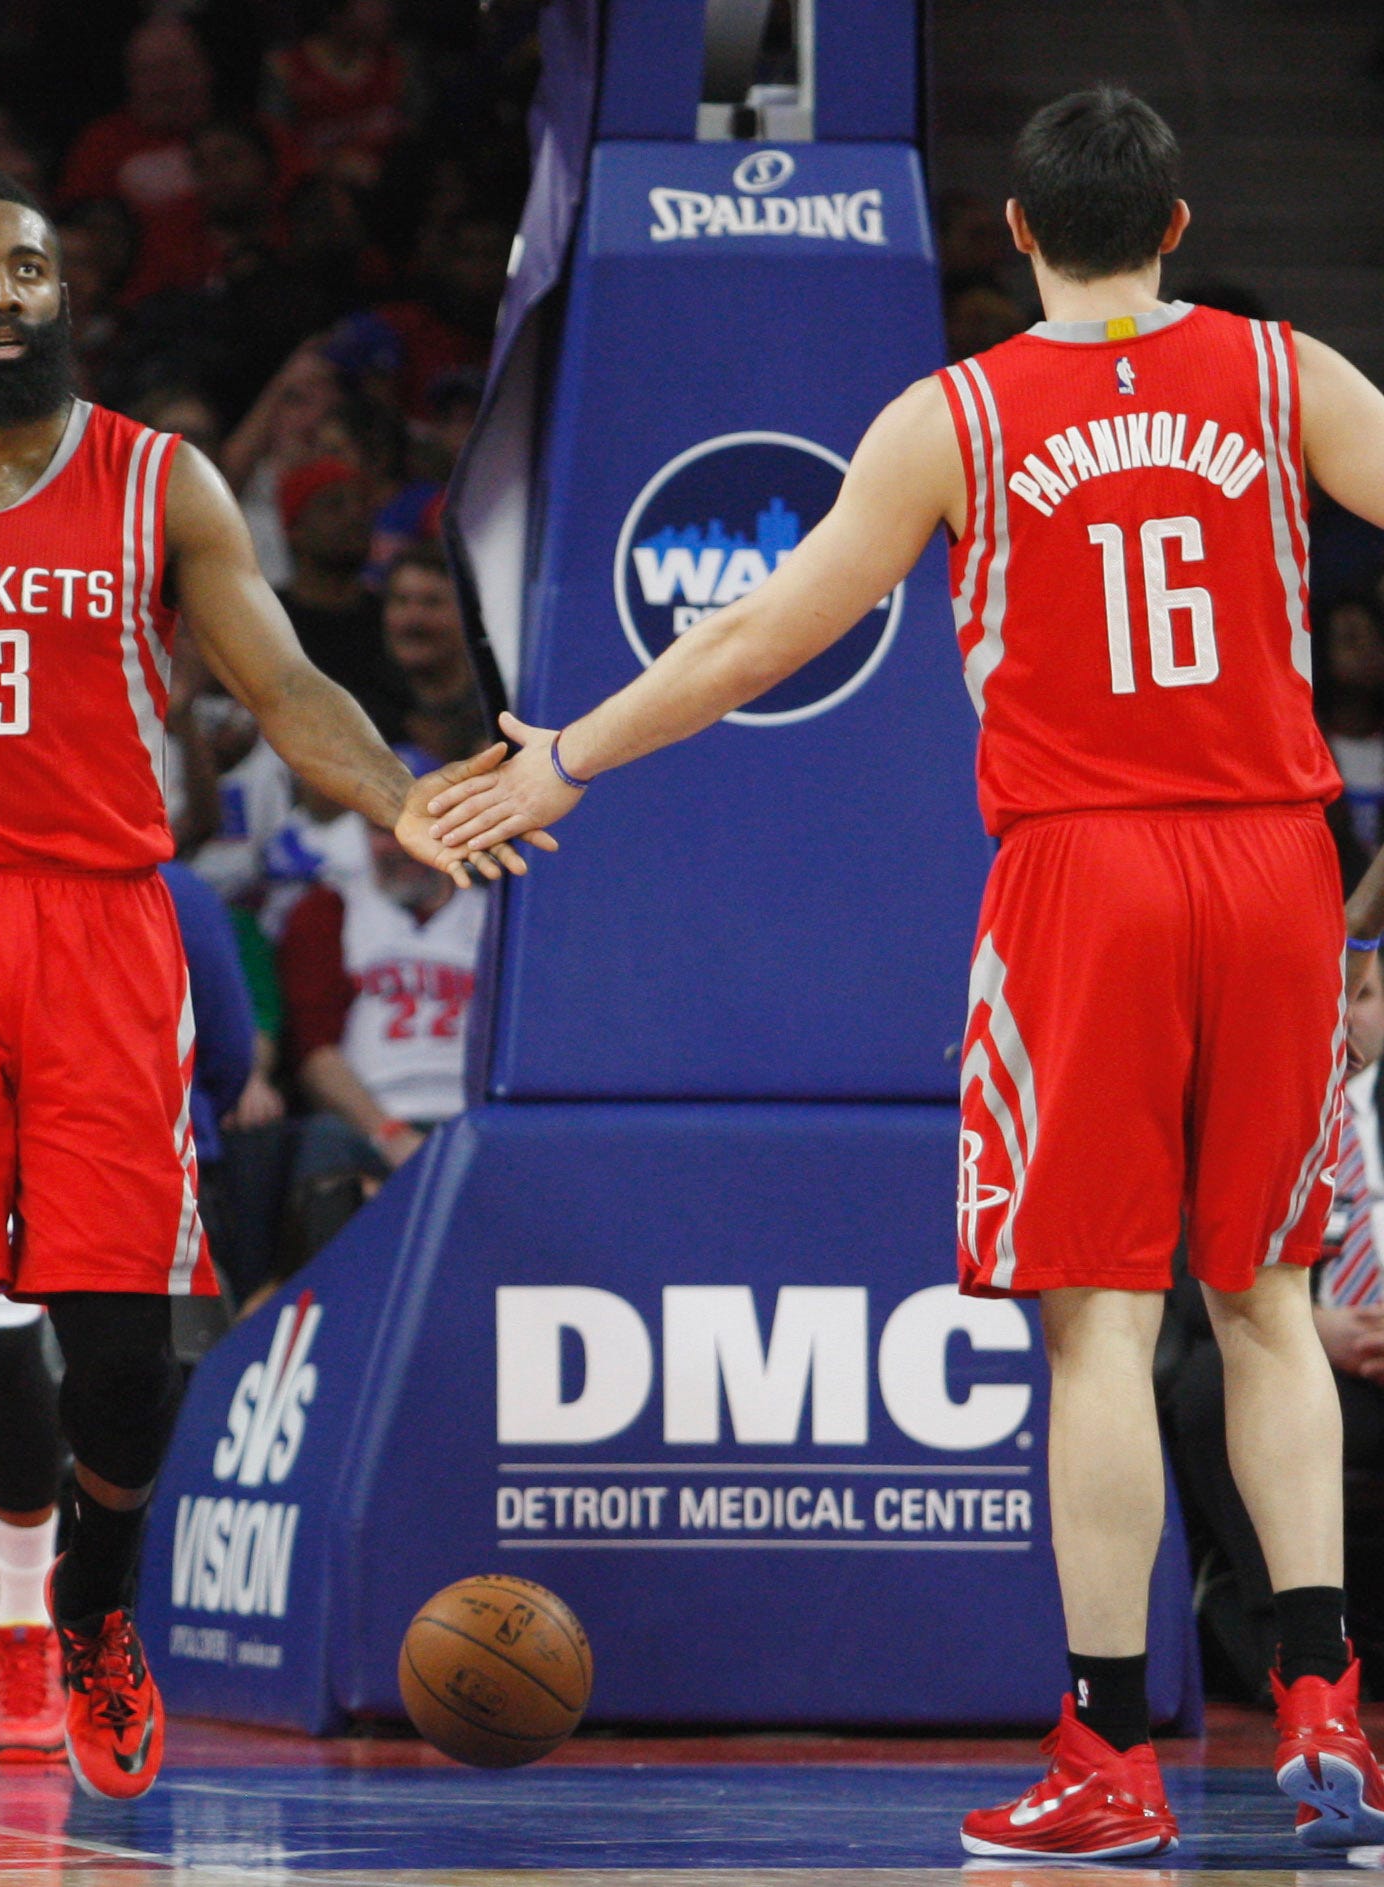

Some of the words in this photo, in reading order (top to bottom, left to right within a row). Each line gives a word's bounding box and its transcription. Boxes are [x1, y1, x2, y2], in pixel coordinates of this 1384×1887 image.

[648, 186, 888, 246] SPALDING
[1008, 411, 1265, 517] PAPANIKOLAOU
[1087, 516, 1220, 694] 16
[496, 1284, 1032, 1451] DMC
[171, 1494, 300, 1619] VISION
[496, 1486, 667, 1531] DETROIT
[679, 1486, 865, 1532] MEDICAL
[874, 1487, 1032, 1533] CENTER
